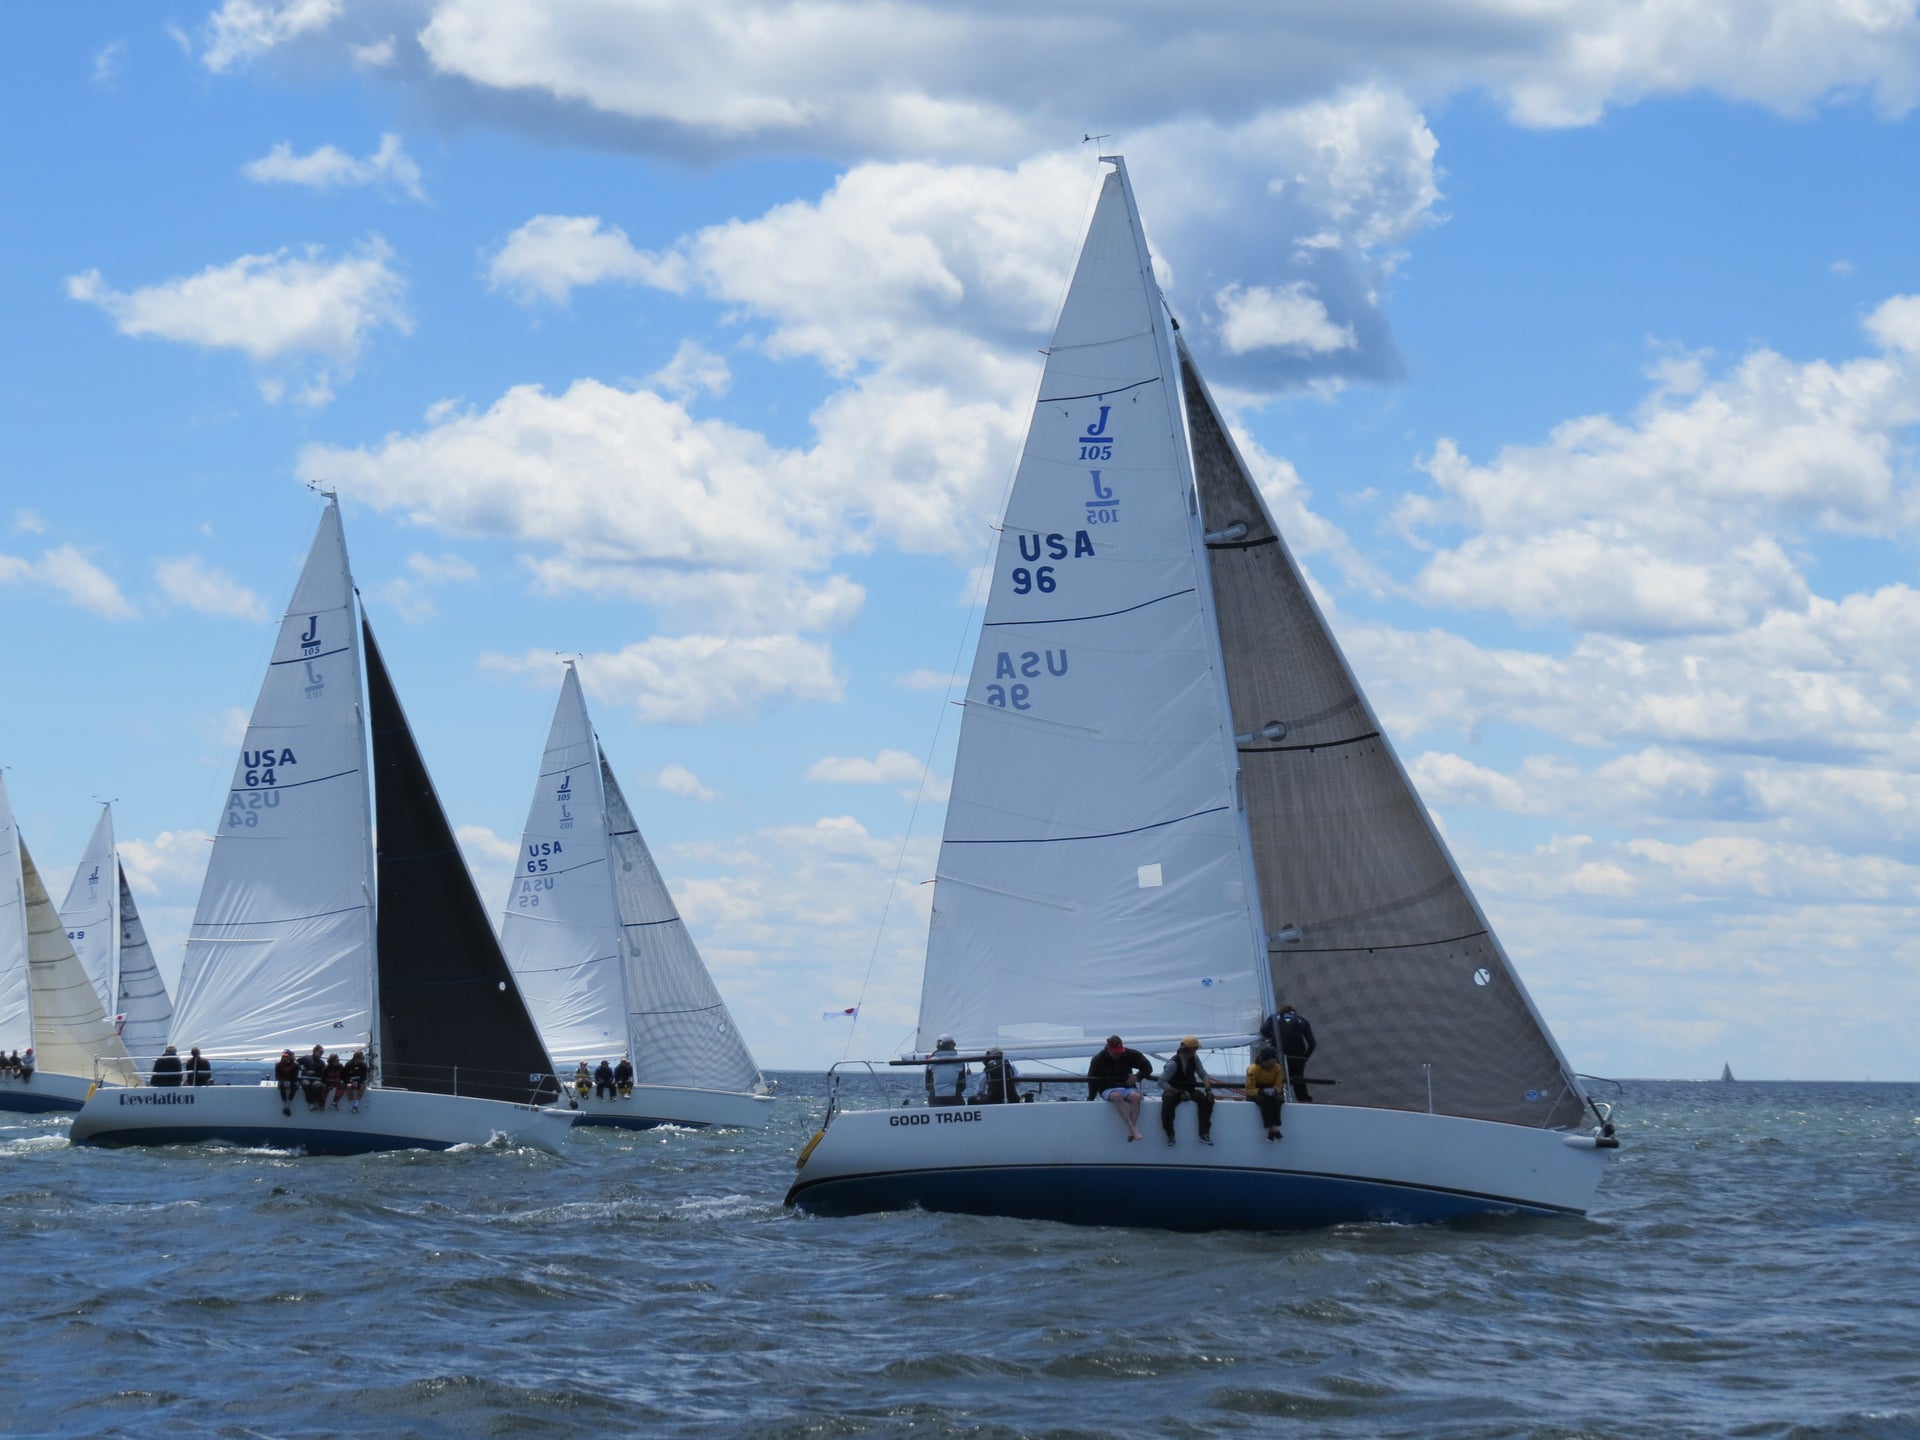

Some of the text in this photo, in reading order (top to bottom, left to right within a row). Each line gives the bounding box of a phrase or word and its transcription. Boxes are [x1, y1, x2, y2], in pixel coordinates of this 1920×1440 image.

[1086, 406, 1111, 435] J
[1078, 446, 1112, 460] 105
[1019, 530, 1095, 562] USA
[1012, 566, 1056, 595] 96
[301, 615, 318, 642] J
[304, 646, 320, 656] 105
[244, 748, 297, 768] USA
[245, 769, 277, 787] 64
[560, 775, 571, 790] J
[529, 841, 562, 857] USA
[527, 859, 548, 873] 65
[890, 1111, 982, 1126] GOOD TRADE
